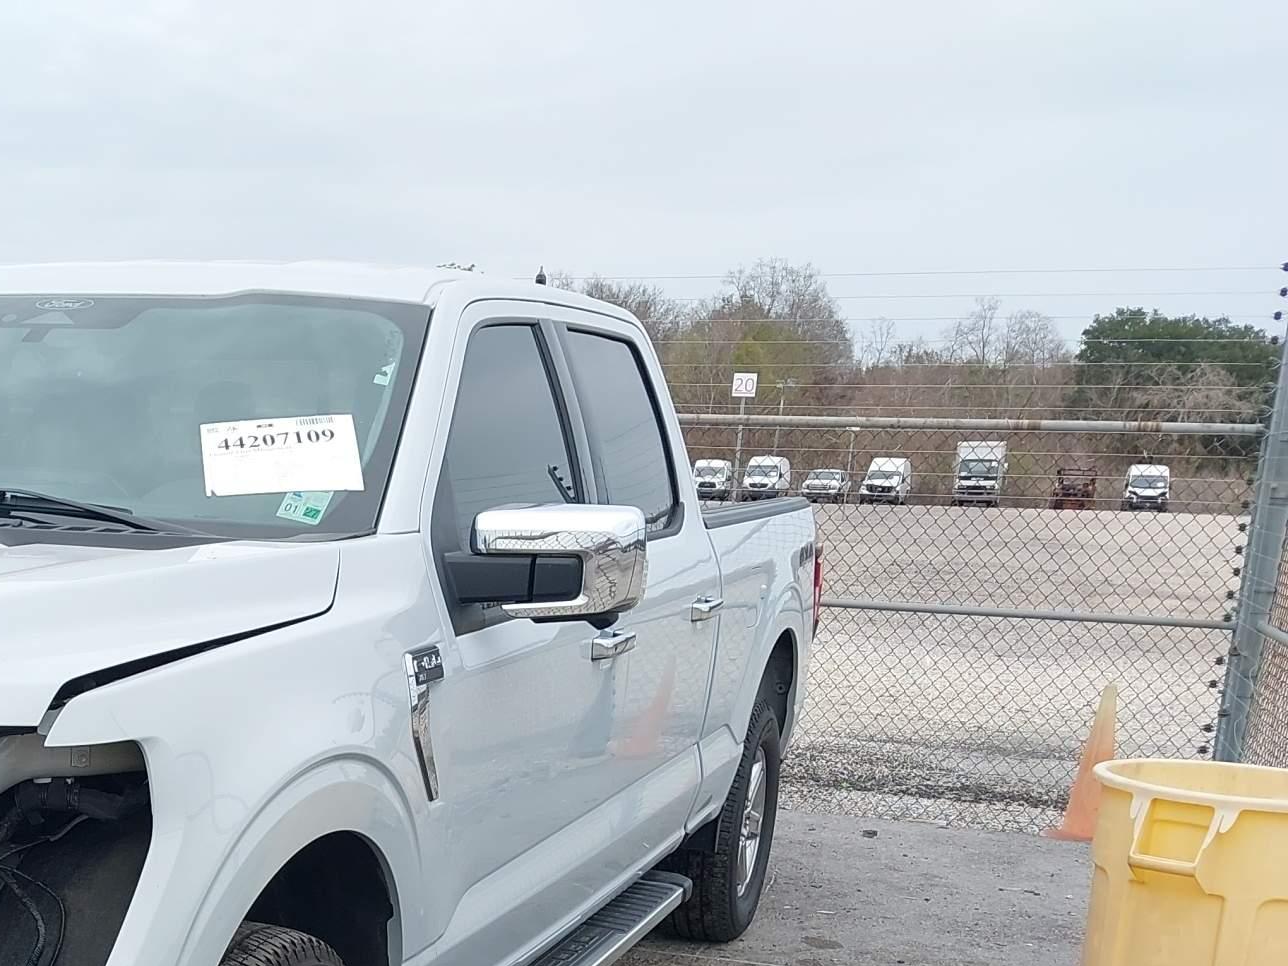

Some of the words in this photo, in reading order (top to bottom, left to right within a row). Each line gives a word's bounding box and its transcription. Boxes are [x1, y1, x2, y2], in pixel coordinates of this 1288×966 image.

[734, 377, 755, 392] 20
[217, 428, 335, 451] 44207109
[284, 502, 299, 514] 01
